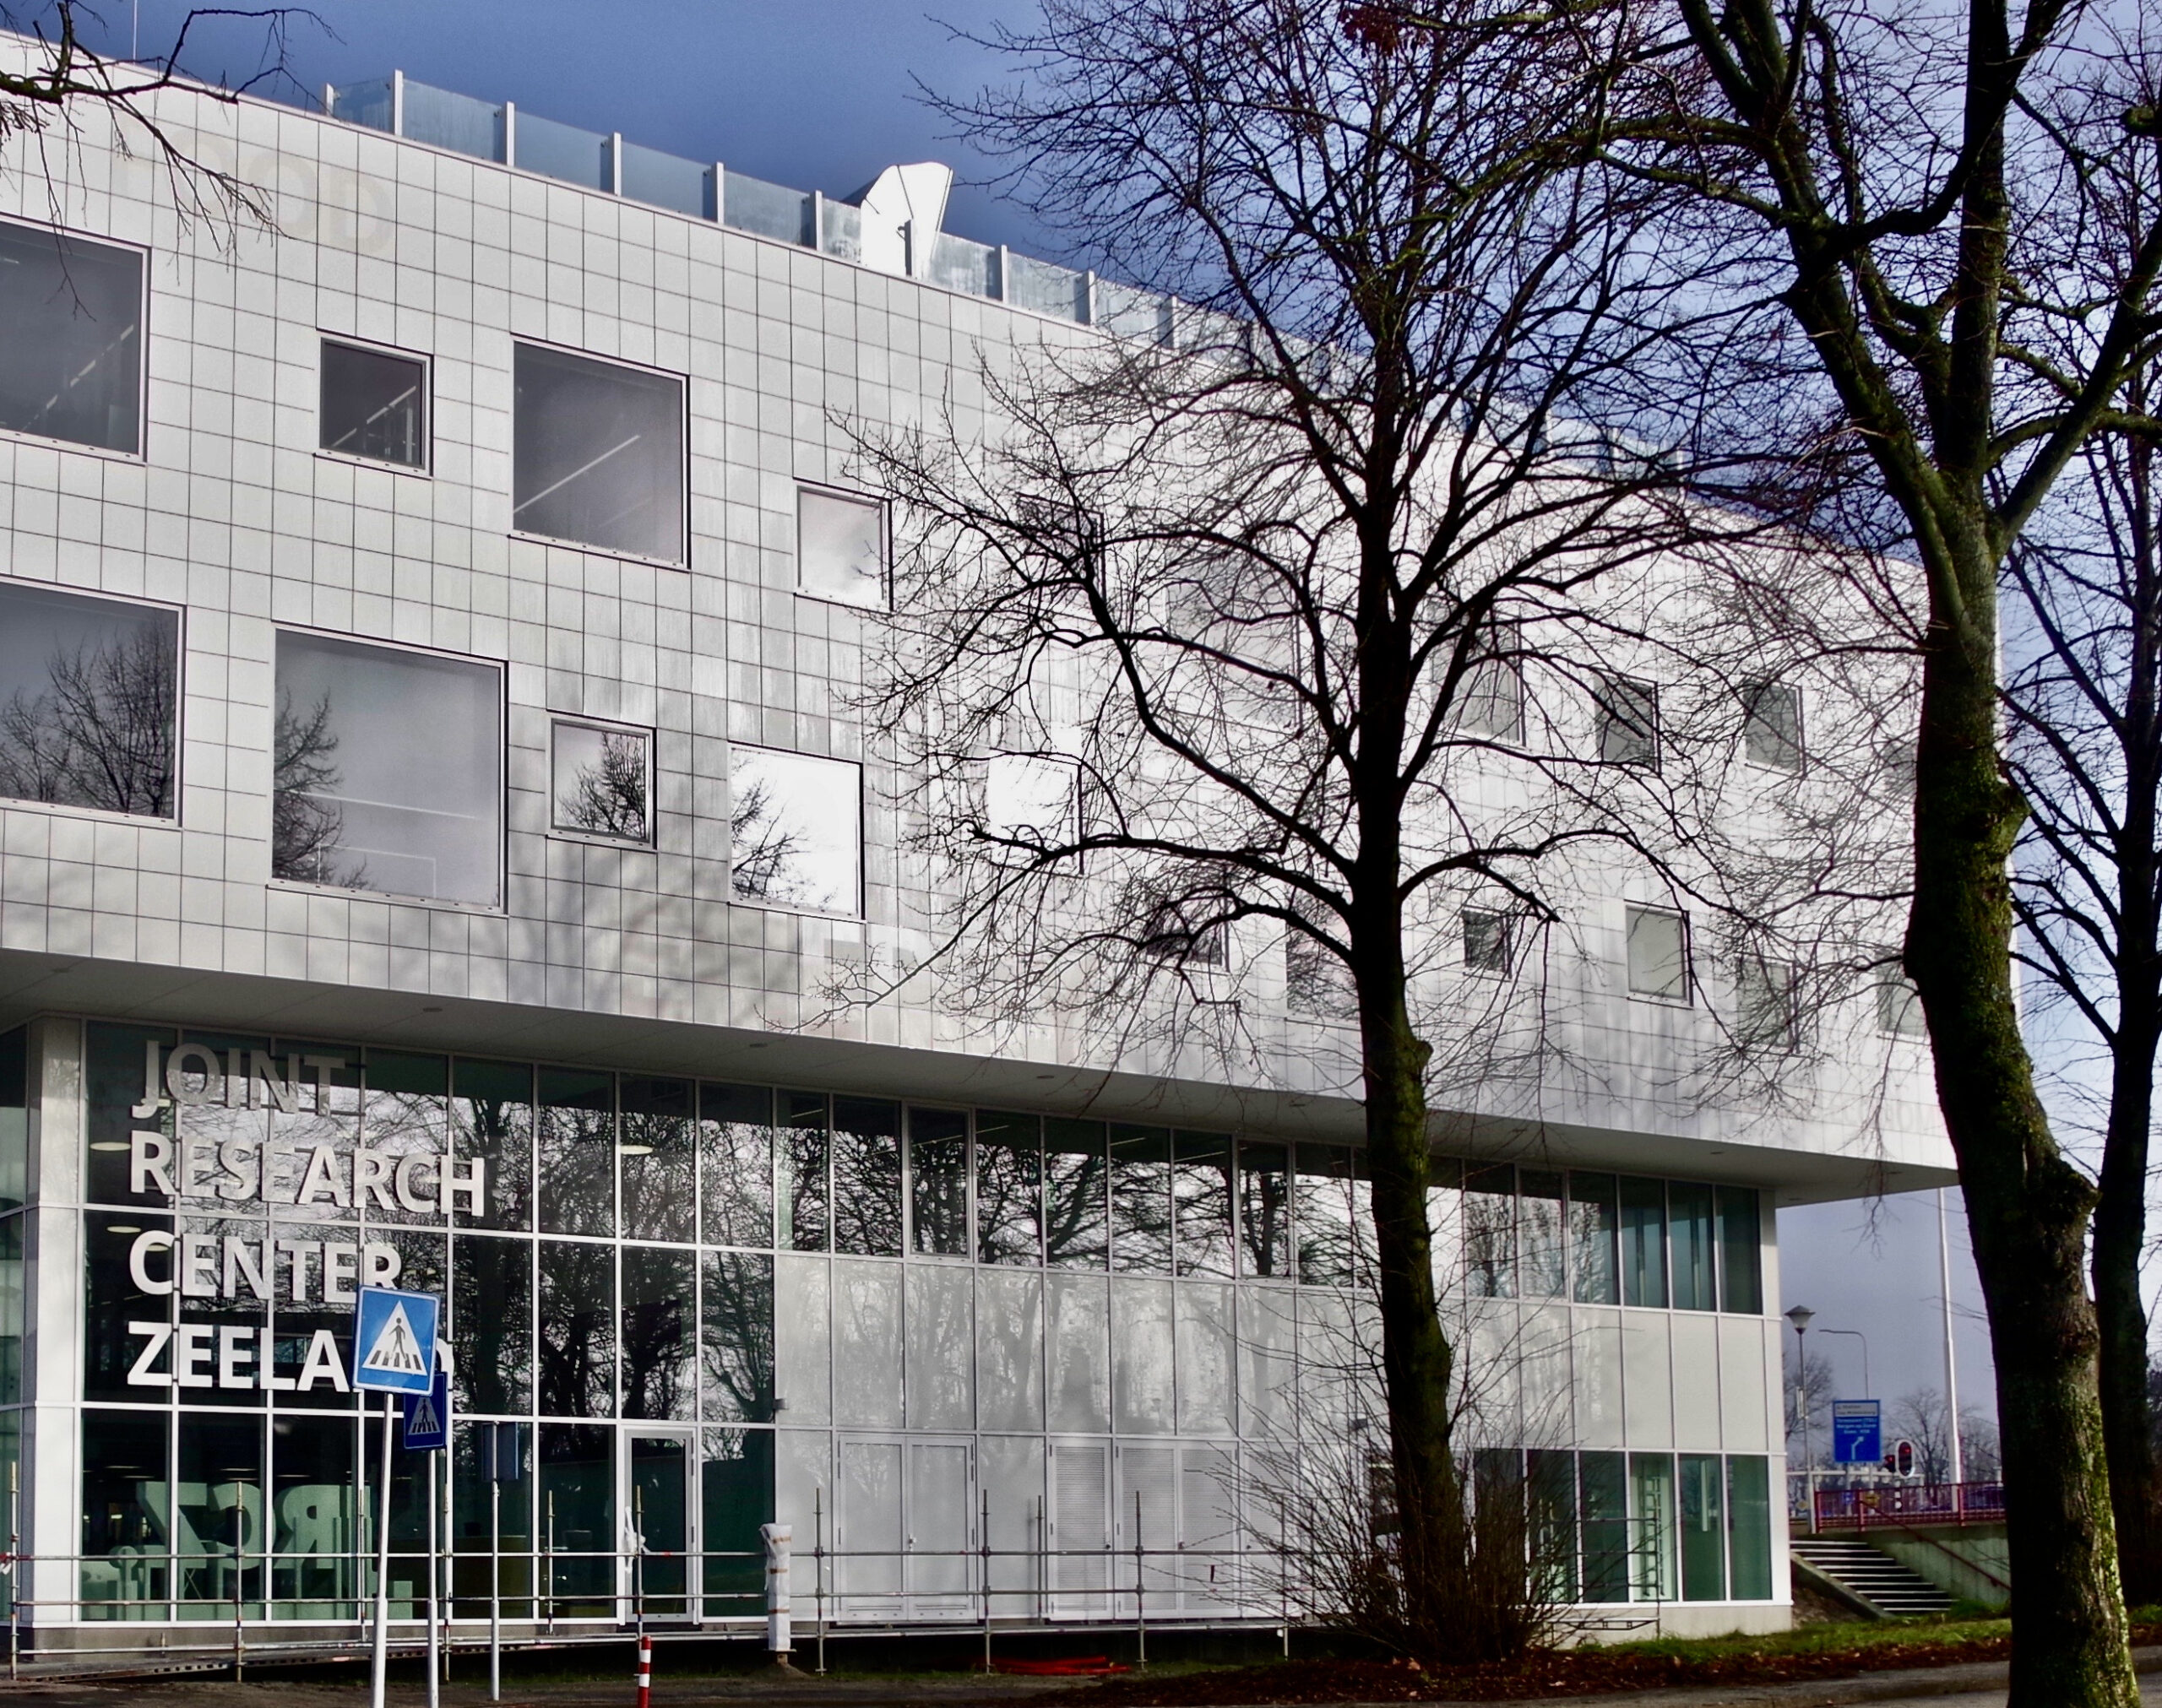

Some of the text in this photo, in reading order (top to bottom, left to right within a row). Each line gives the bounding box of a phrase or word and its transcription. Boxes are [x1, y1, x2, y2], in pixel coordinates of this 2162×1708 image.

[131, 1039, 345, 1120] JOINT
[130, 1130, 485, 1217] RESEARCH
[128, 1230, 402, 1303] CENTER
[127, 1321, 454, 1392] ZEELA
